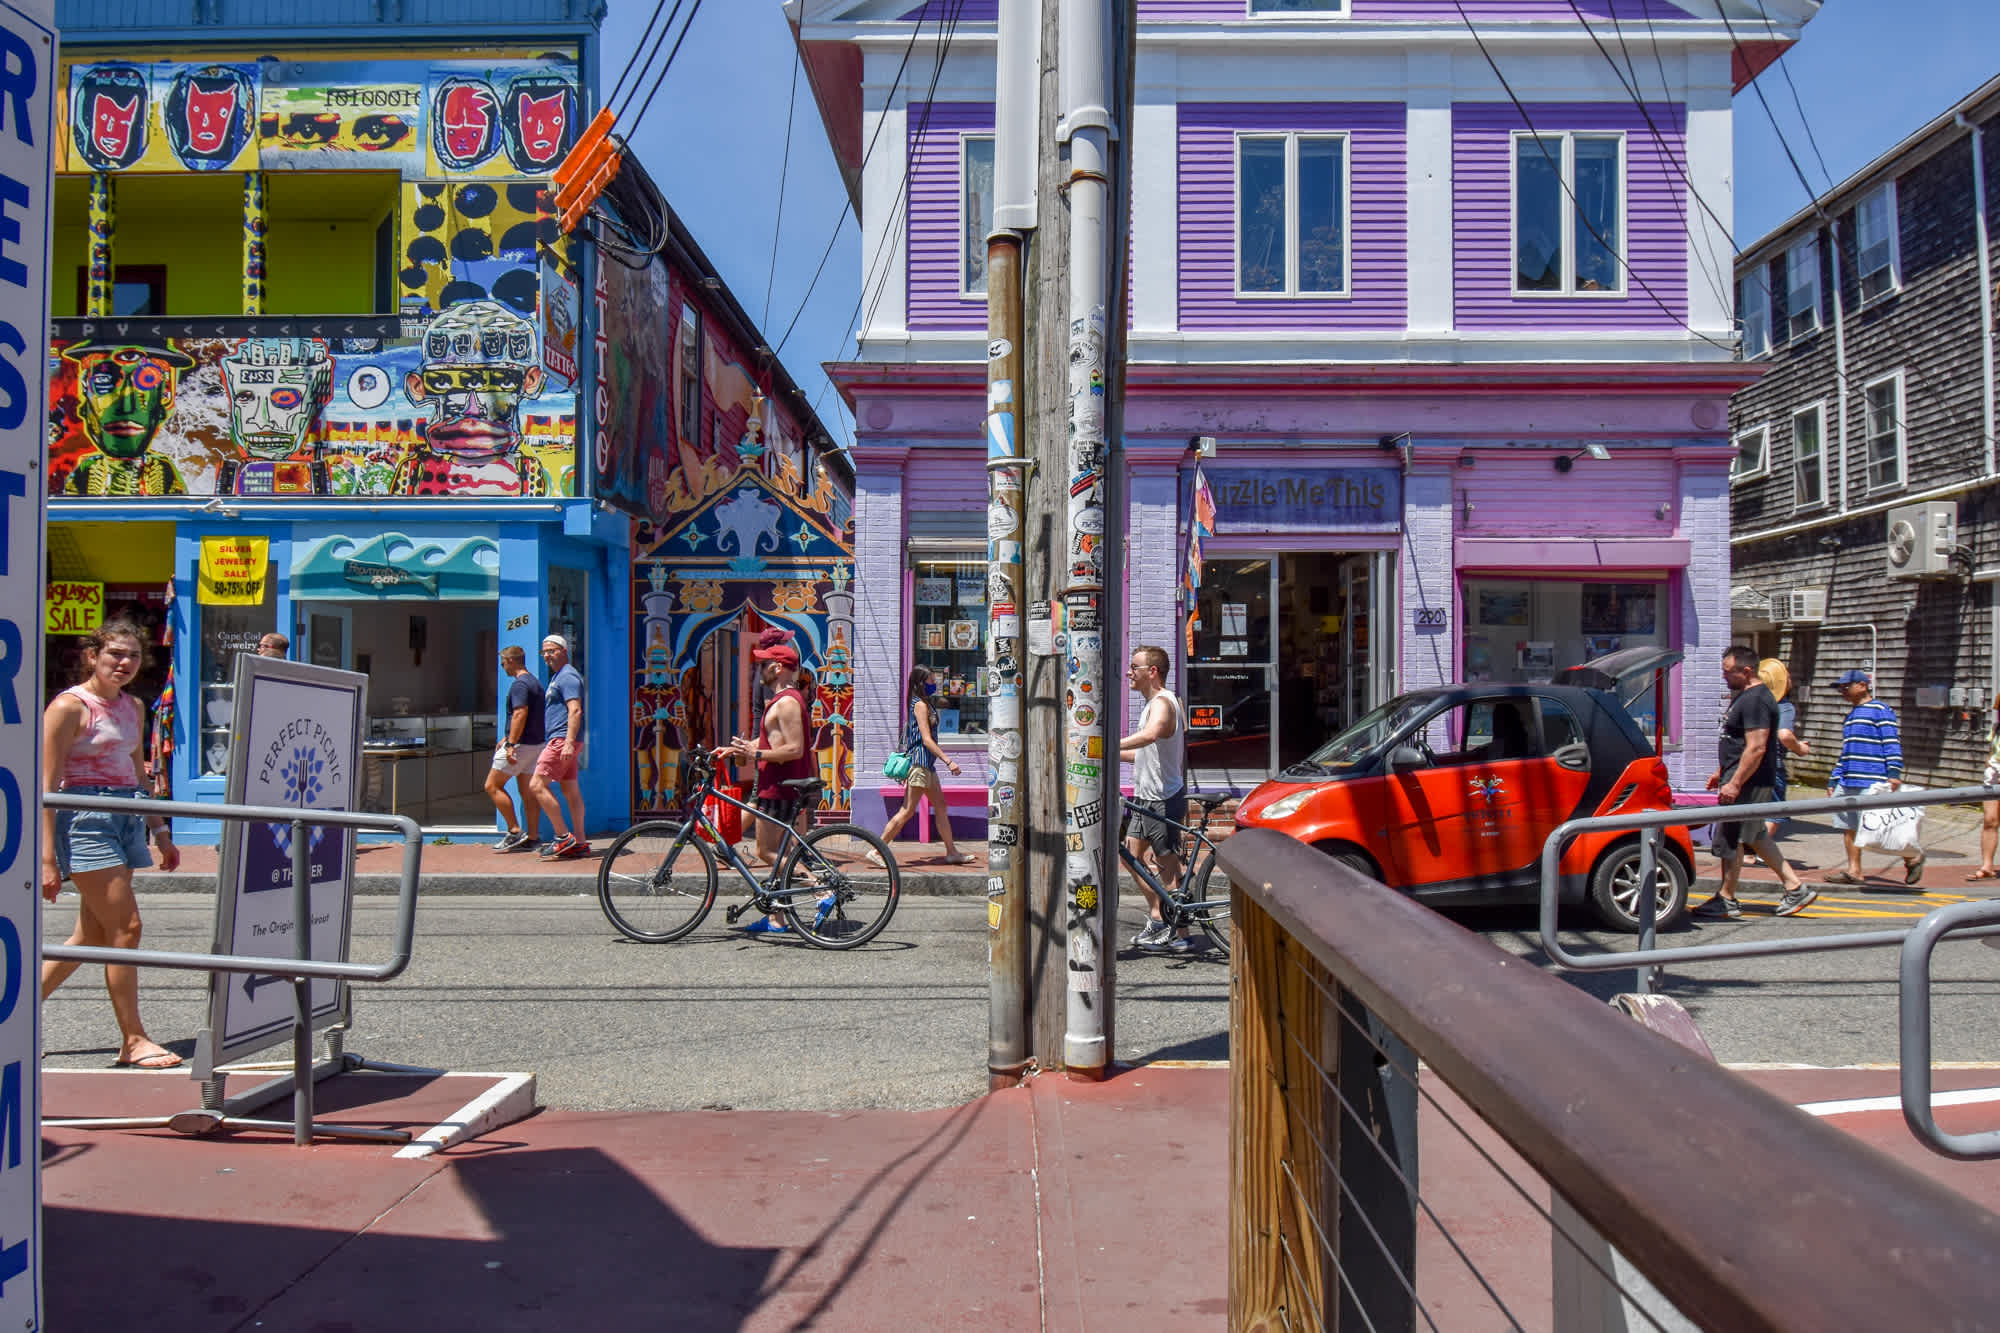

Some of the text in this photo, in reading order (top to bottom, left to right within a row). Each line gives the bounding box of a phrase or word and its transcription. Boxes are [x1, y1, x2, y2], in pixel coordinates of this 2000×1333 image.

[1326, 478, 1385, 509] This
[214, 558, 257, 566] JEWELRY
[224, 570, 248, 578] SALE
[246, 582, 260, 594] OFF
[48, 607, 96, 632] SALE
[1418, 608, 1444, 624] 290
[507, 614, 529, 631] 286
[217, 631, 261, 642] Cape Cod
[222, 640, 257, 651] Jewelry
[1196, 709, 1215, 717] HELP
[1191, 717, 1220, 727] WANTED
[259, 718, 342, 785] PERFECT PICNIC
[252, 924, 267, 937] The
[269, 920, 295, 935] Origin
